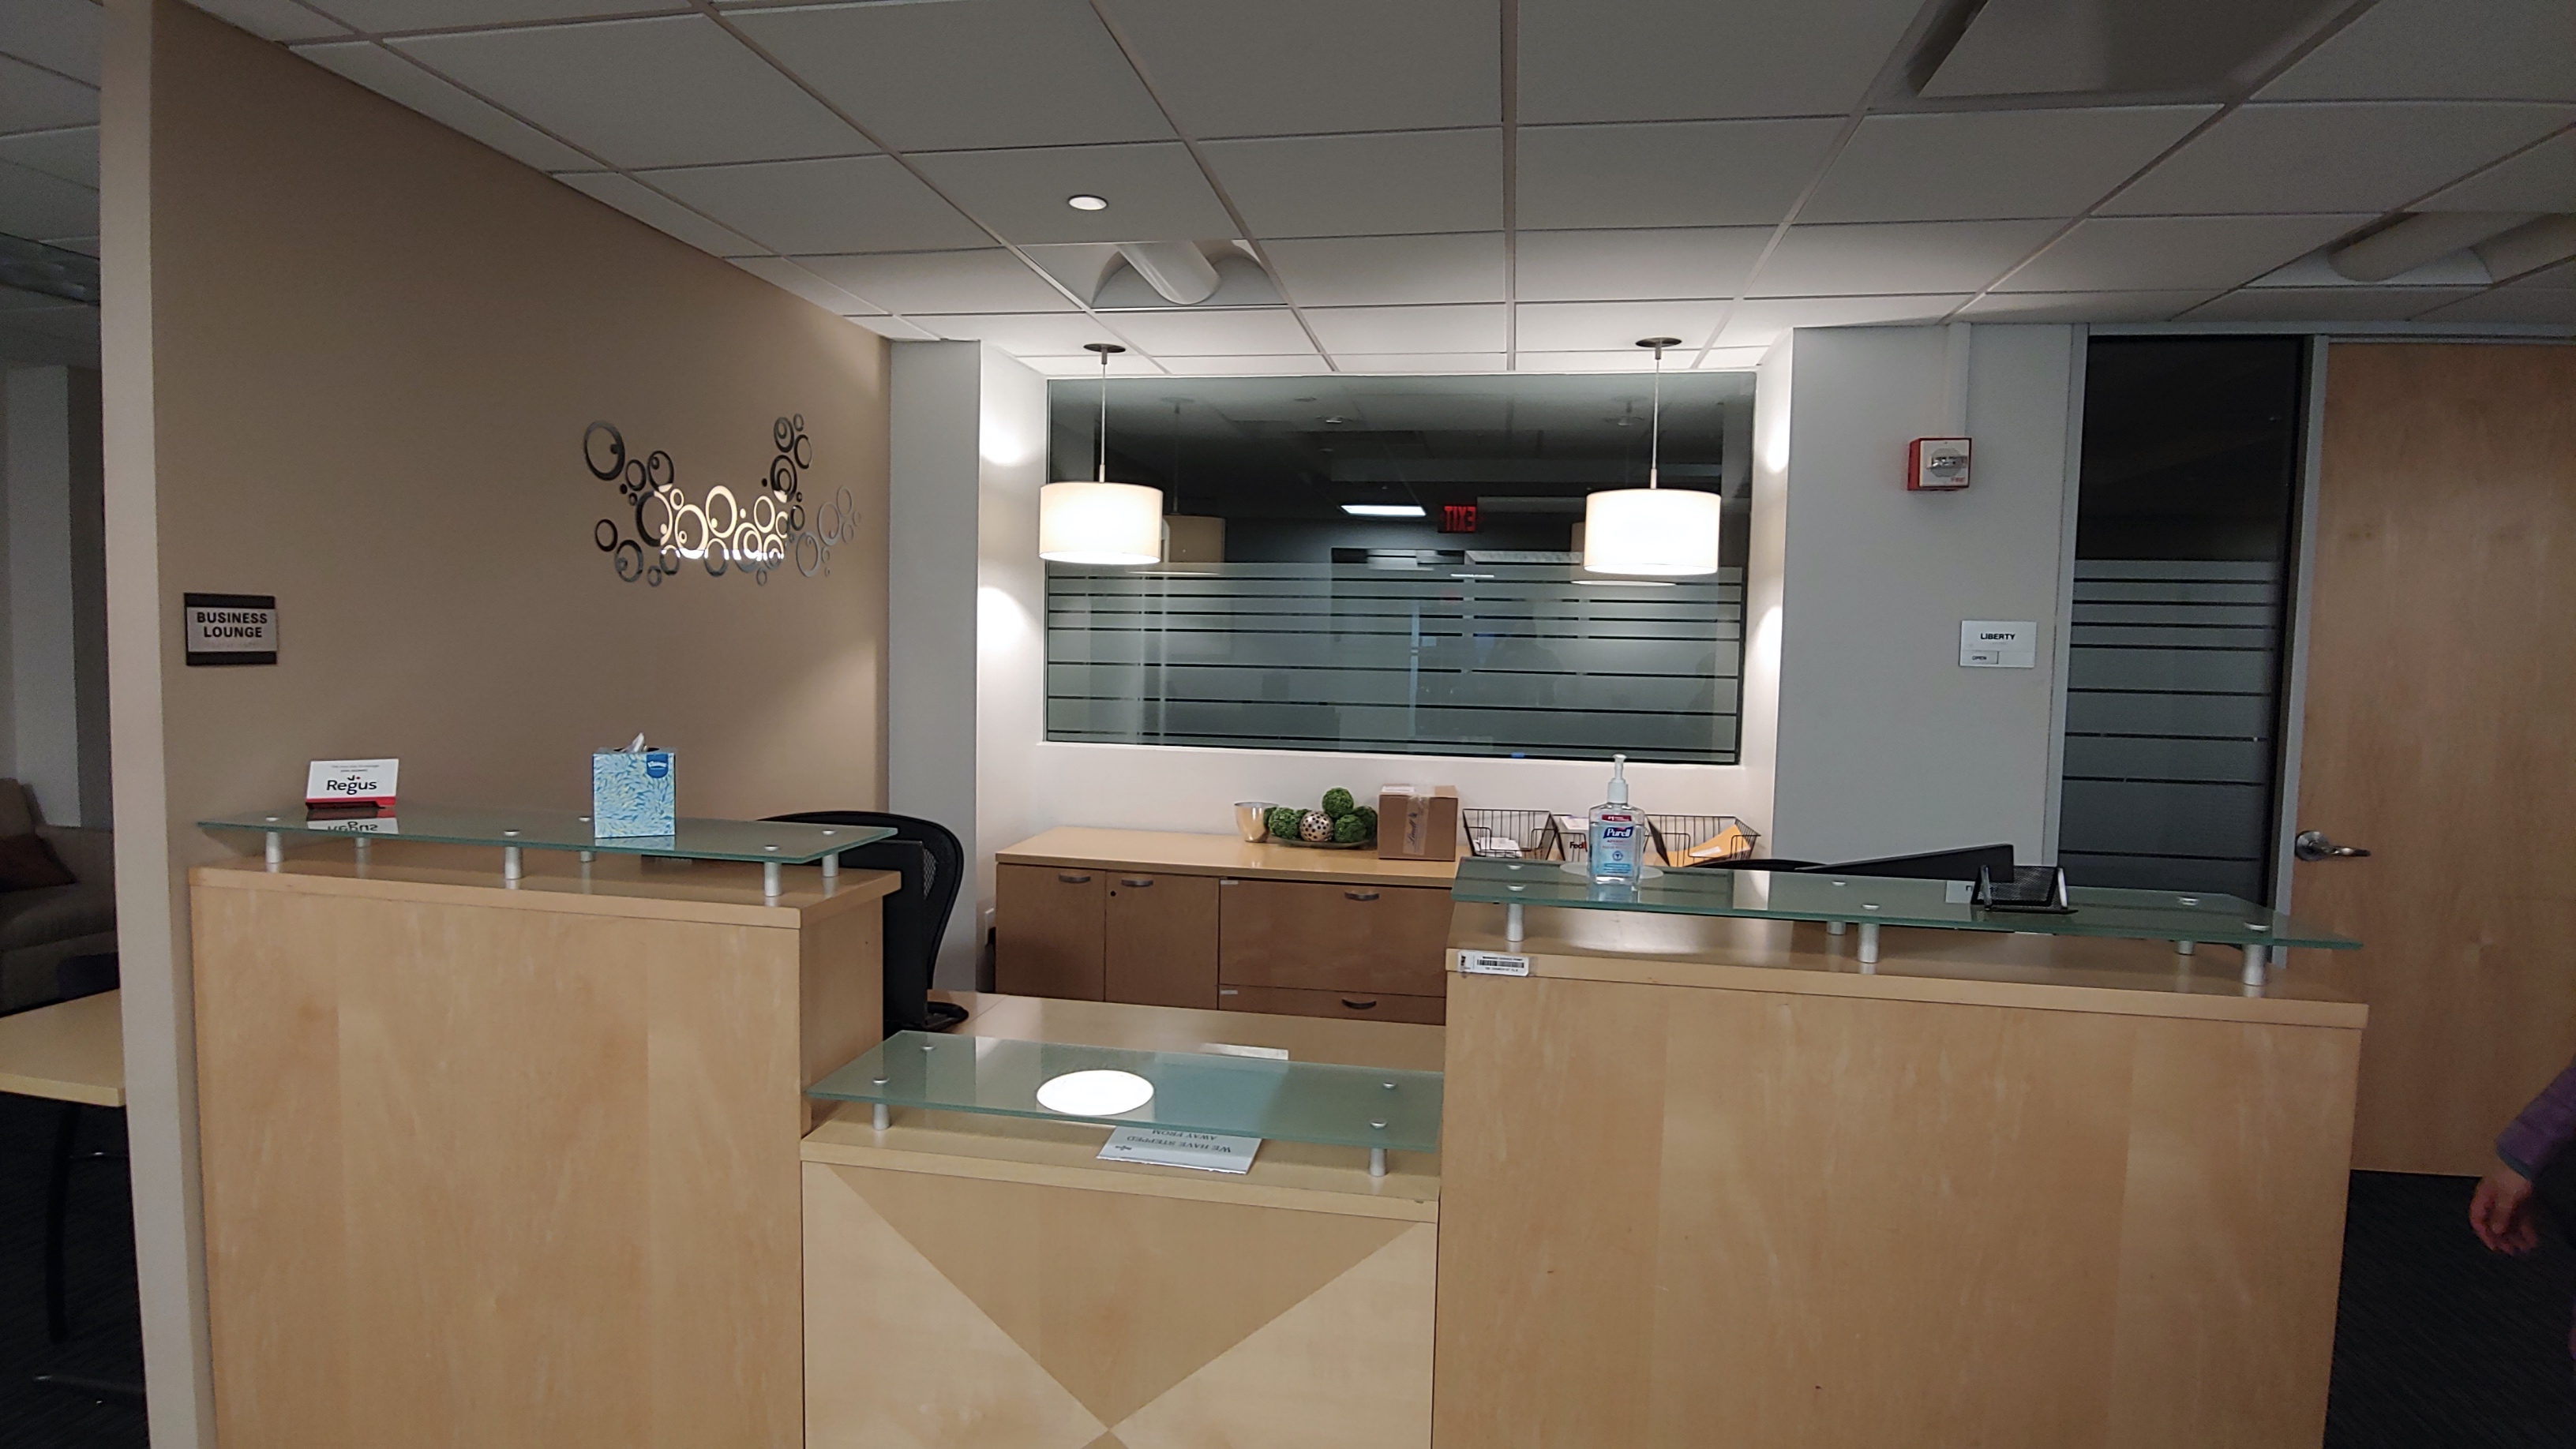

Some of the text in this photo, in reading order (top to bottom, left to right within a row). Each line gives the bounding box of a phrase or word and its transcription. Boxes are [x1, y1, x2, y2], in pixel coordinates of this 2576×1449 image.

[197, 612, 268, 623] BUSINESS
[204, 627, 263, 638] LOUNGE
[326, 780, 377, 795] Regus
[1607, 828, 1631, 837] Purell
[1127, 1136, 1176, 1146] STEPPED
